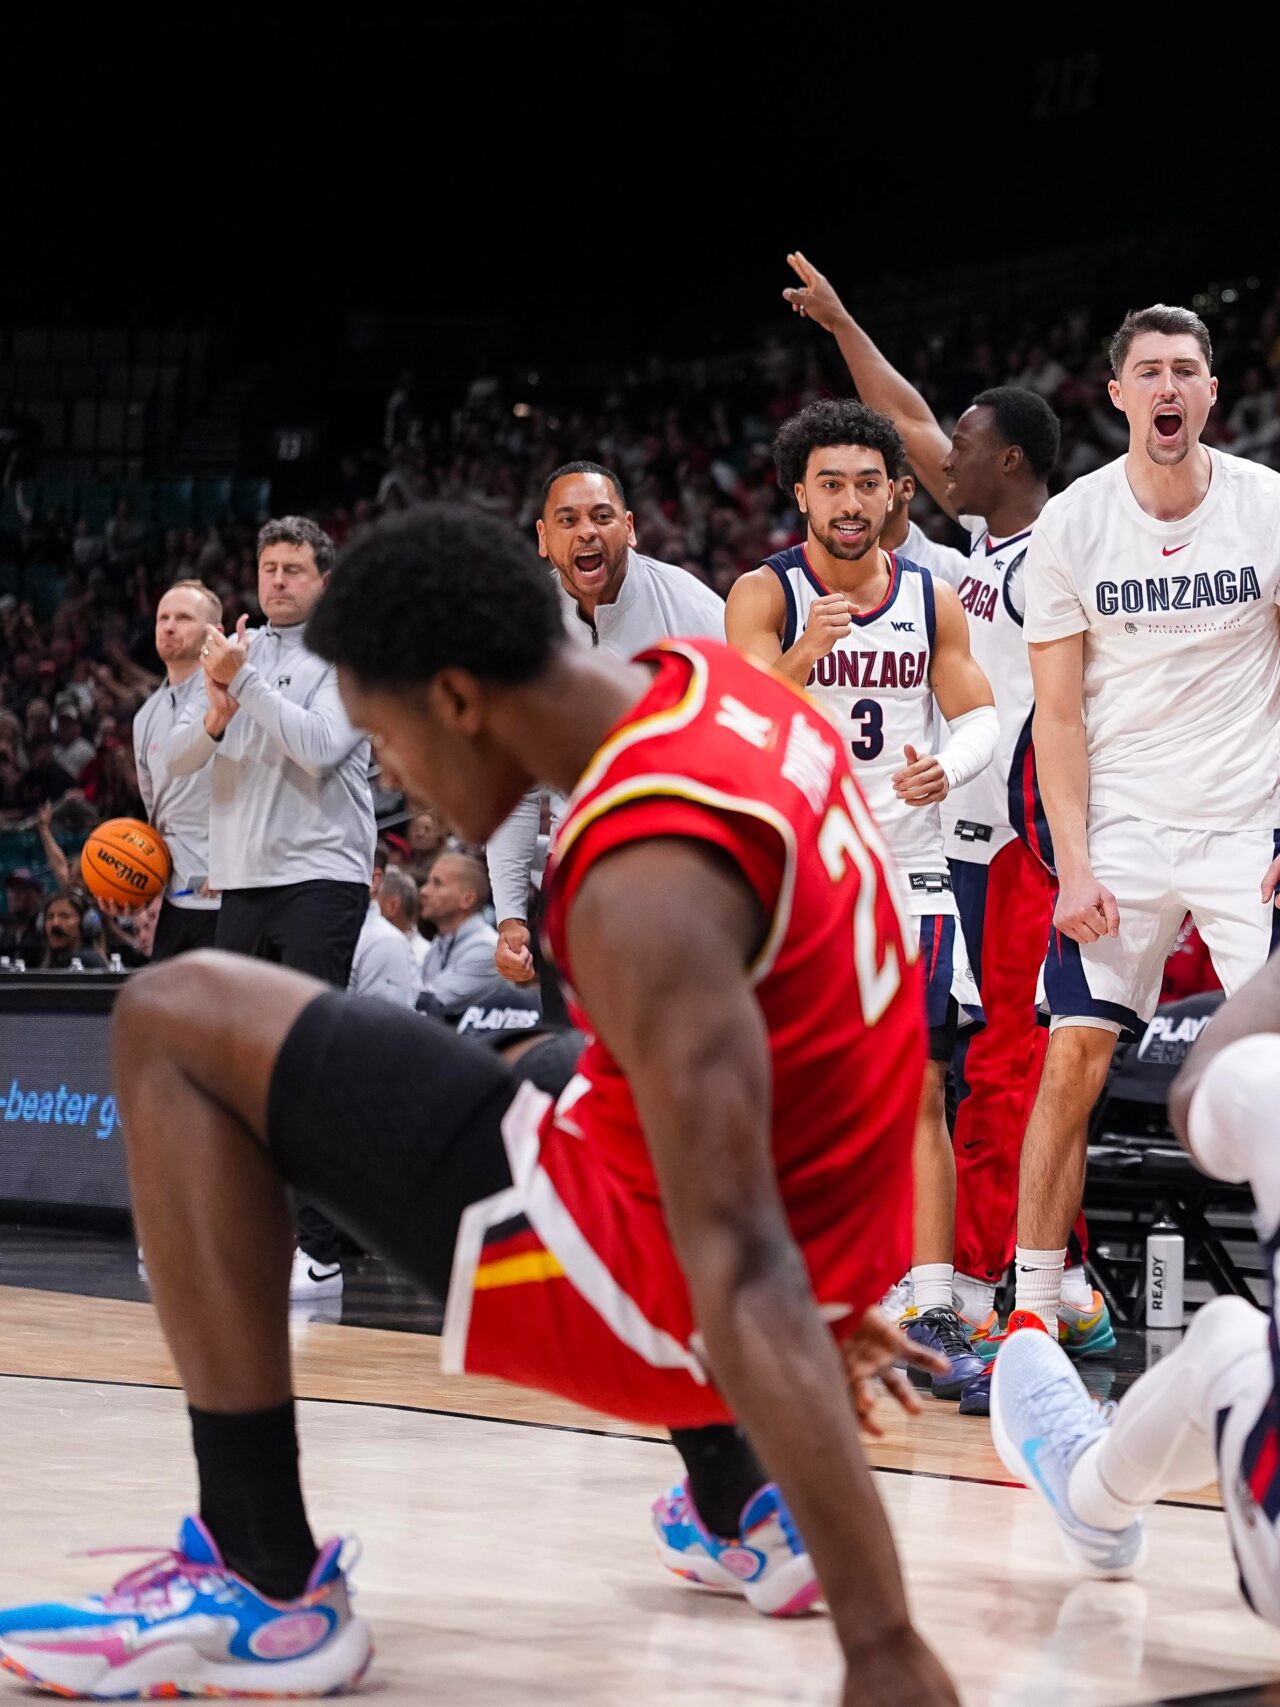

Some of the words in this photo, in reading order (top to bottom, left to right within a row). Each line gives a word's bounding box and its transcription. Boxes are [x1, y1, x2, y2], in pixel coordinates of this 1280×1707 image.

[1096, 566, 1262, 615] GONZAGA
[850, 698, 885, 762] 3
[97, 848, 148, 890] Wilson
[1152, 1256, 1165, 1311] READY
